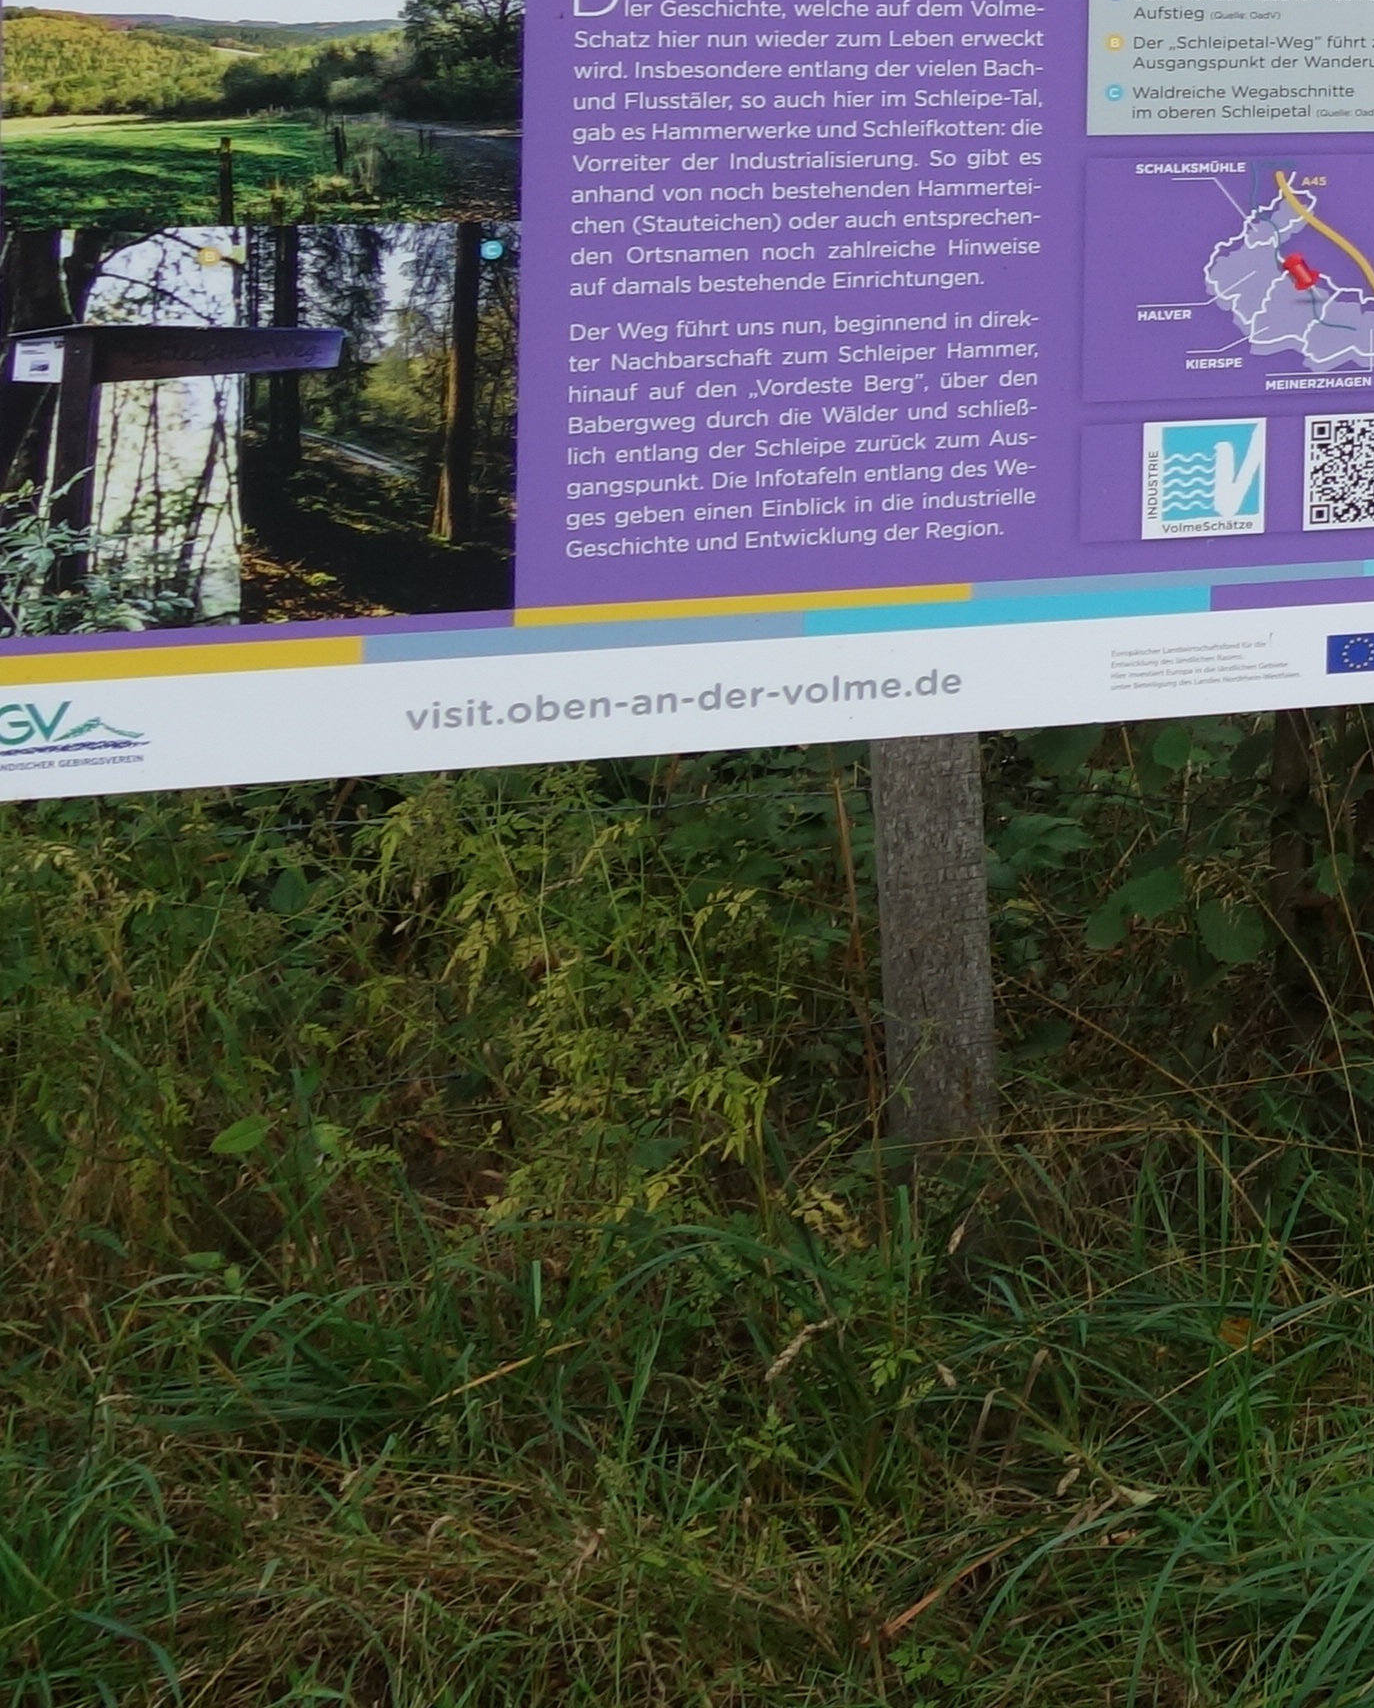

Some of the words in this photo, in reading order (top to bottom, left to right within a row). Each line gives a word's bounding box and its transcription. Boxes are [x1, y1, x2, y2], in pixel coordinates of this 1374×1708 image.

[625, 0, 653, 17] ler
[660, 0, 786, 19] Geschichte,
[794, 0, 869, 16] welche
[876, 0, 910, 16] auf
[917, 0, 962, 16] dem
[971, 0, 1044, 16] Volme-
[1134, 6, 1204, 22] Aufstieg
[574, 30, 650, 48] Schatz
[658, 30, 700, 47] hier
[707, 35, 747, 47] nun
[755, 30, 829, 47] wieder
[836, 34, 881, 47] zum
[890, 30, 953, 46] Leben
[961, 29, 1044, 46] erweckt
[1134, 37, 1164, 49] Der
[1327, 35, 1366, 48] führt
[574, 61, 627, 79] wird.
[636, 61, 782, 78] Insbesondere
[788, 60, 868, 80] entlang
[875, 60, 910, 77] der
[916, 60, 977, 76] vielen
[984, 59, 1043, 76] Bach-
[1133, 56, 1265, 71] Ausgangspunkt
[1271, 56, 1298, 68] der
[1133, 86, 1226, 99] Waldreiche
[1231, 85, 1354, 100] Wegabschnitte
[1132, 106, 1151, 118] im
[1158, 106, 1215, 120] oberen
[1222, 105, 1310, 119] Schleipetal
[1136, 162, 1246, 174] SCHALKSMÜHLE
[1302, 176, 1327, 187] A45
[1137, 309, 1192, 321] HALVER
[1186, 357, 1243, 369] KIERSPE
[1265, 377, 1372, 390] MEINERZHAGEN
[1148, 450, 1158, 519] INDUSTRIE
[1162, 520, 1253, 534] VolmeSchätze
[406, 669, 962, 730] visit.oben-an-der-volme.de
